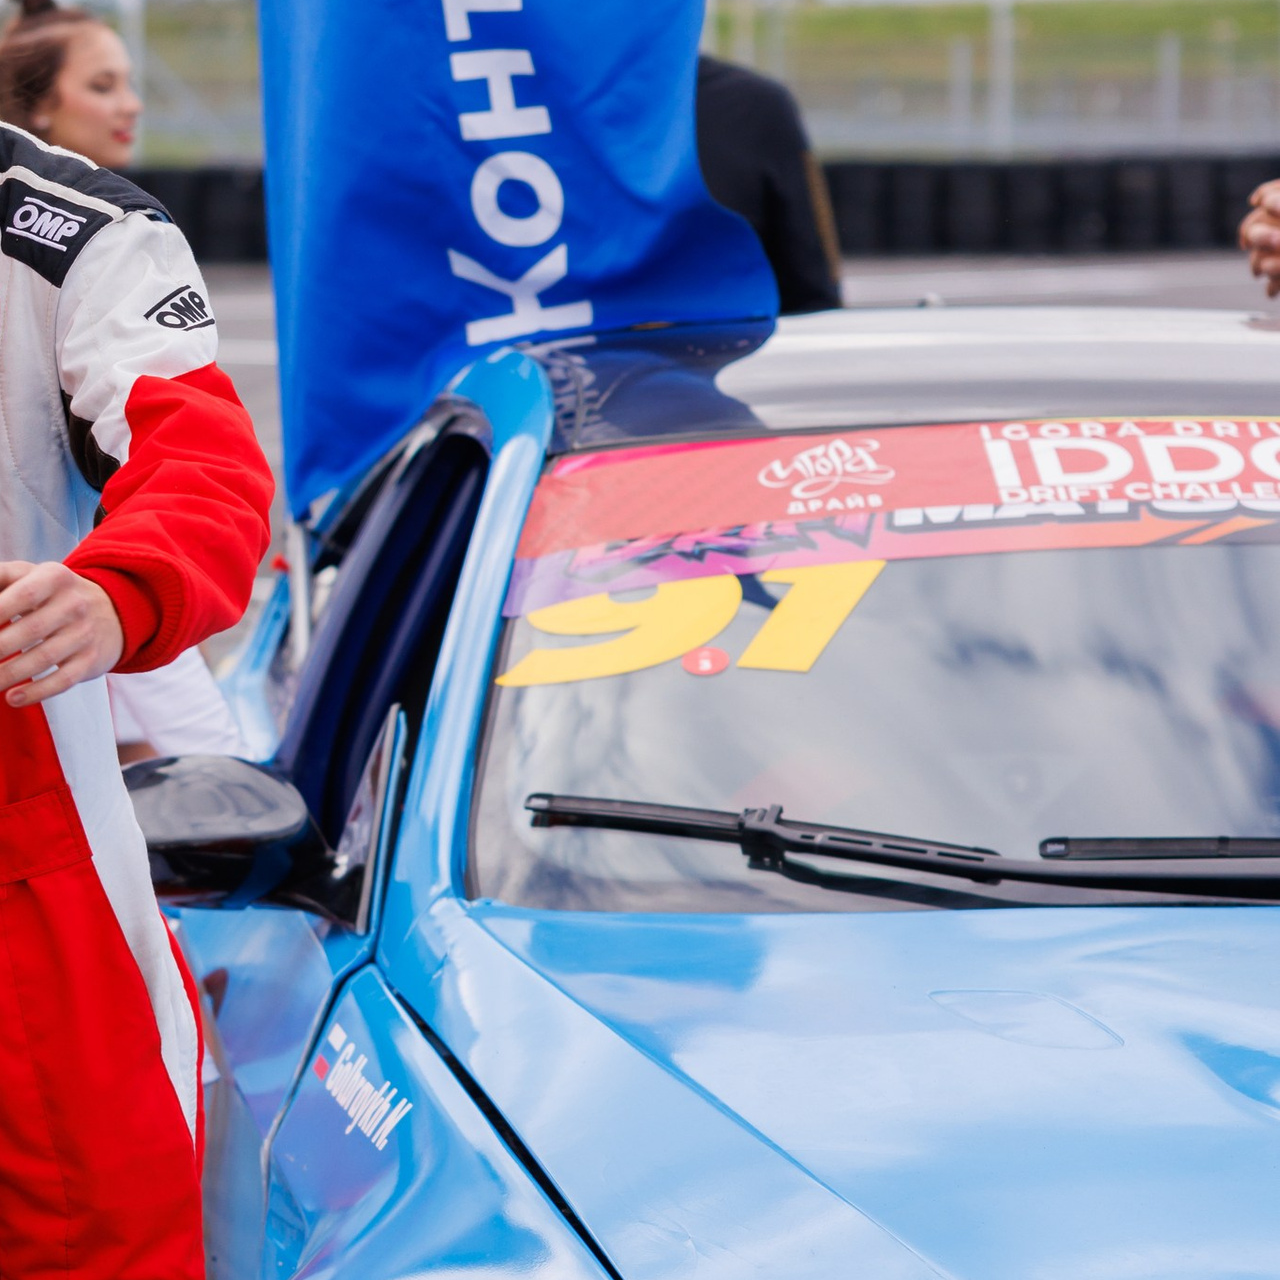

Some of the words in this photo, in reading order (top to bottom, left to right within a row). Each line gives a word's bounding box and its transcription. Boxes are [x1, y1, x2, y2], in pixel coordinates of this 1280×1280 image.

[12, 203, 81, 242] OMP
[155, 290, 210, 329] OMP
[979, 420, 1146, 441] IGORA
[786, 493, 883, 515] ДРАЙВ
[1000, 483, 1114, 504] DRIFT
[1124, 481, 1280, 501] CHALLE
[495, 559, 887, 687] 91
